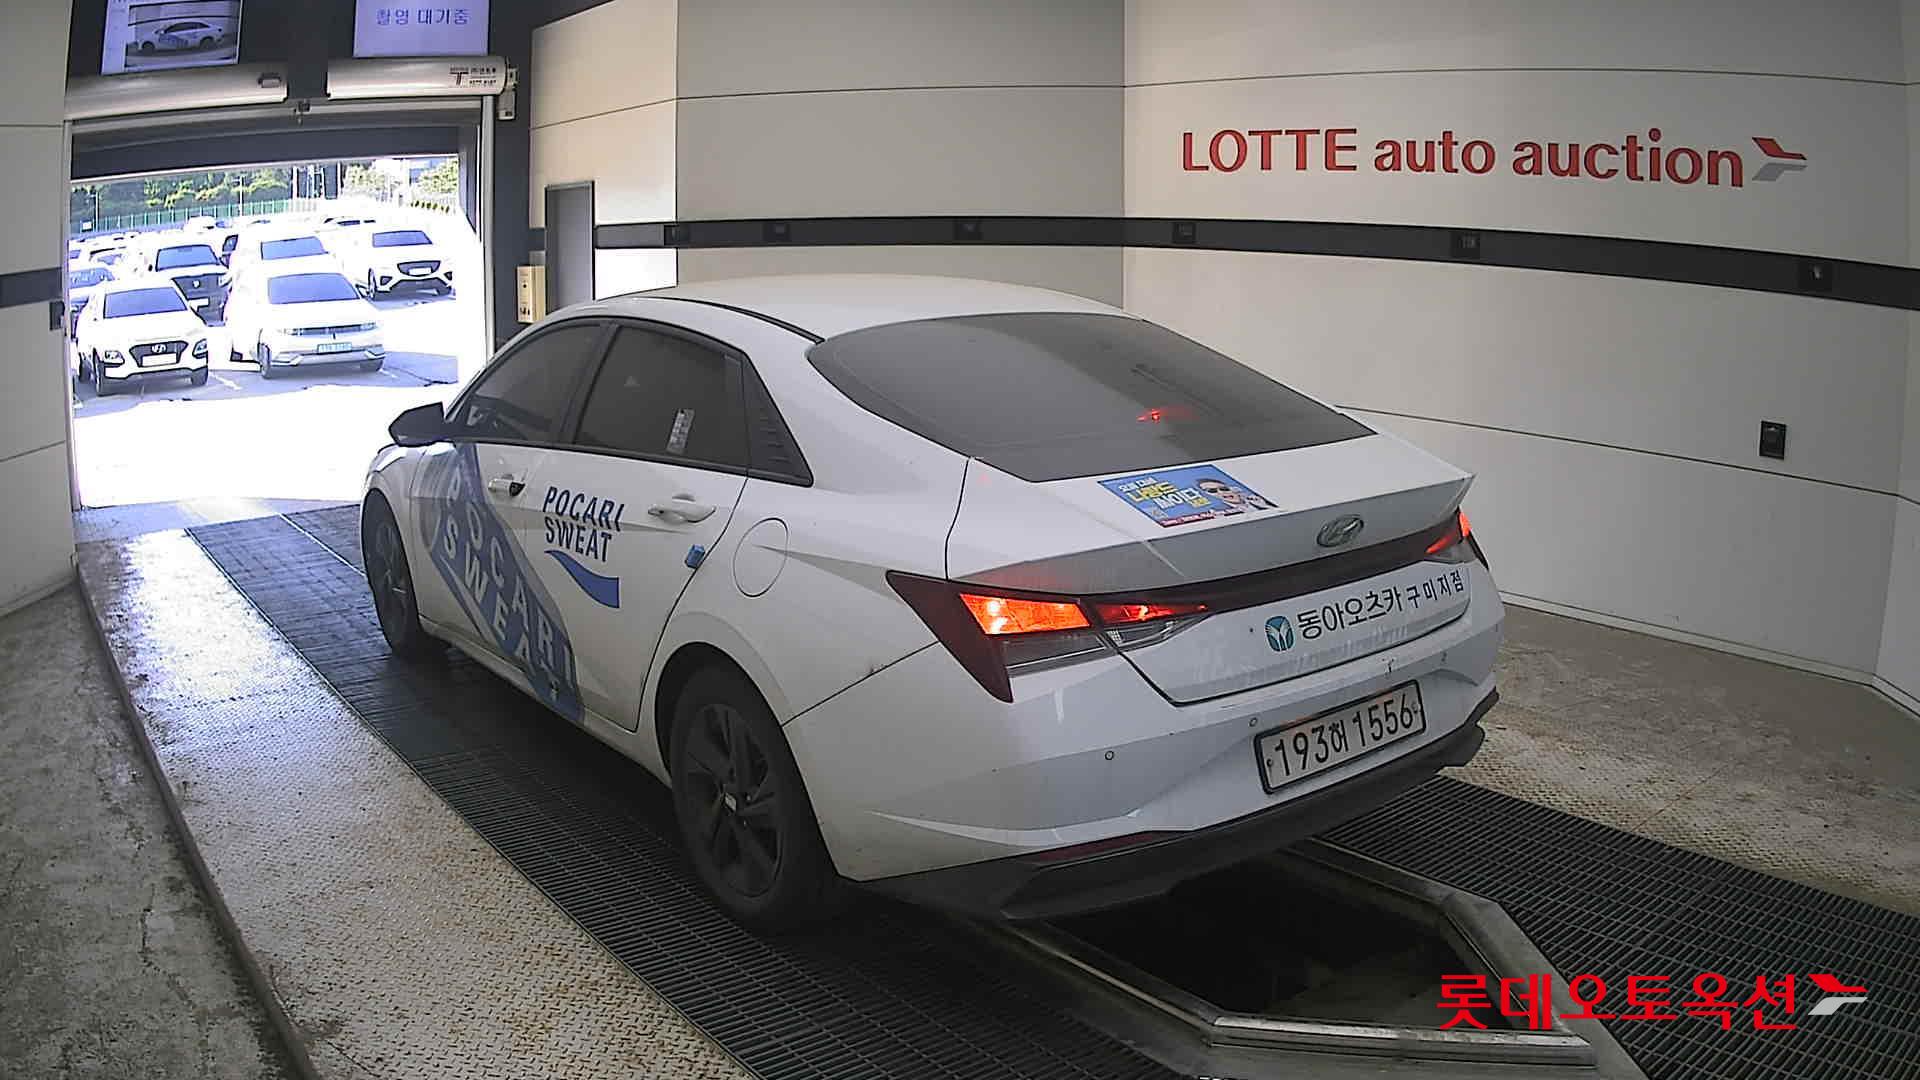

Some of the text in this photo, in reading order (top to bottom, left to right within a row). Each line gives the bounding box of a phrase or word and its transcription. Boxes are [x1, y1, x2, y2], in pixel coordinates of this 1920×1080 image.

[1182, 128, 1744, 188] LOTTE auto auction
[542, 486, 624, 532] POCARI
[544, 516, 612, 562] SWEAT
[1297, 569, 1464, 640] 동아오츠카 구미지점
[1275, 694, 1413, 776] 193허 1556
